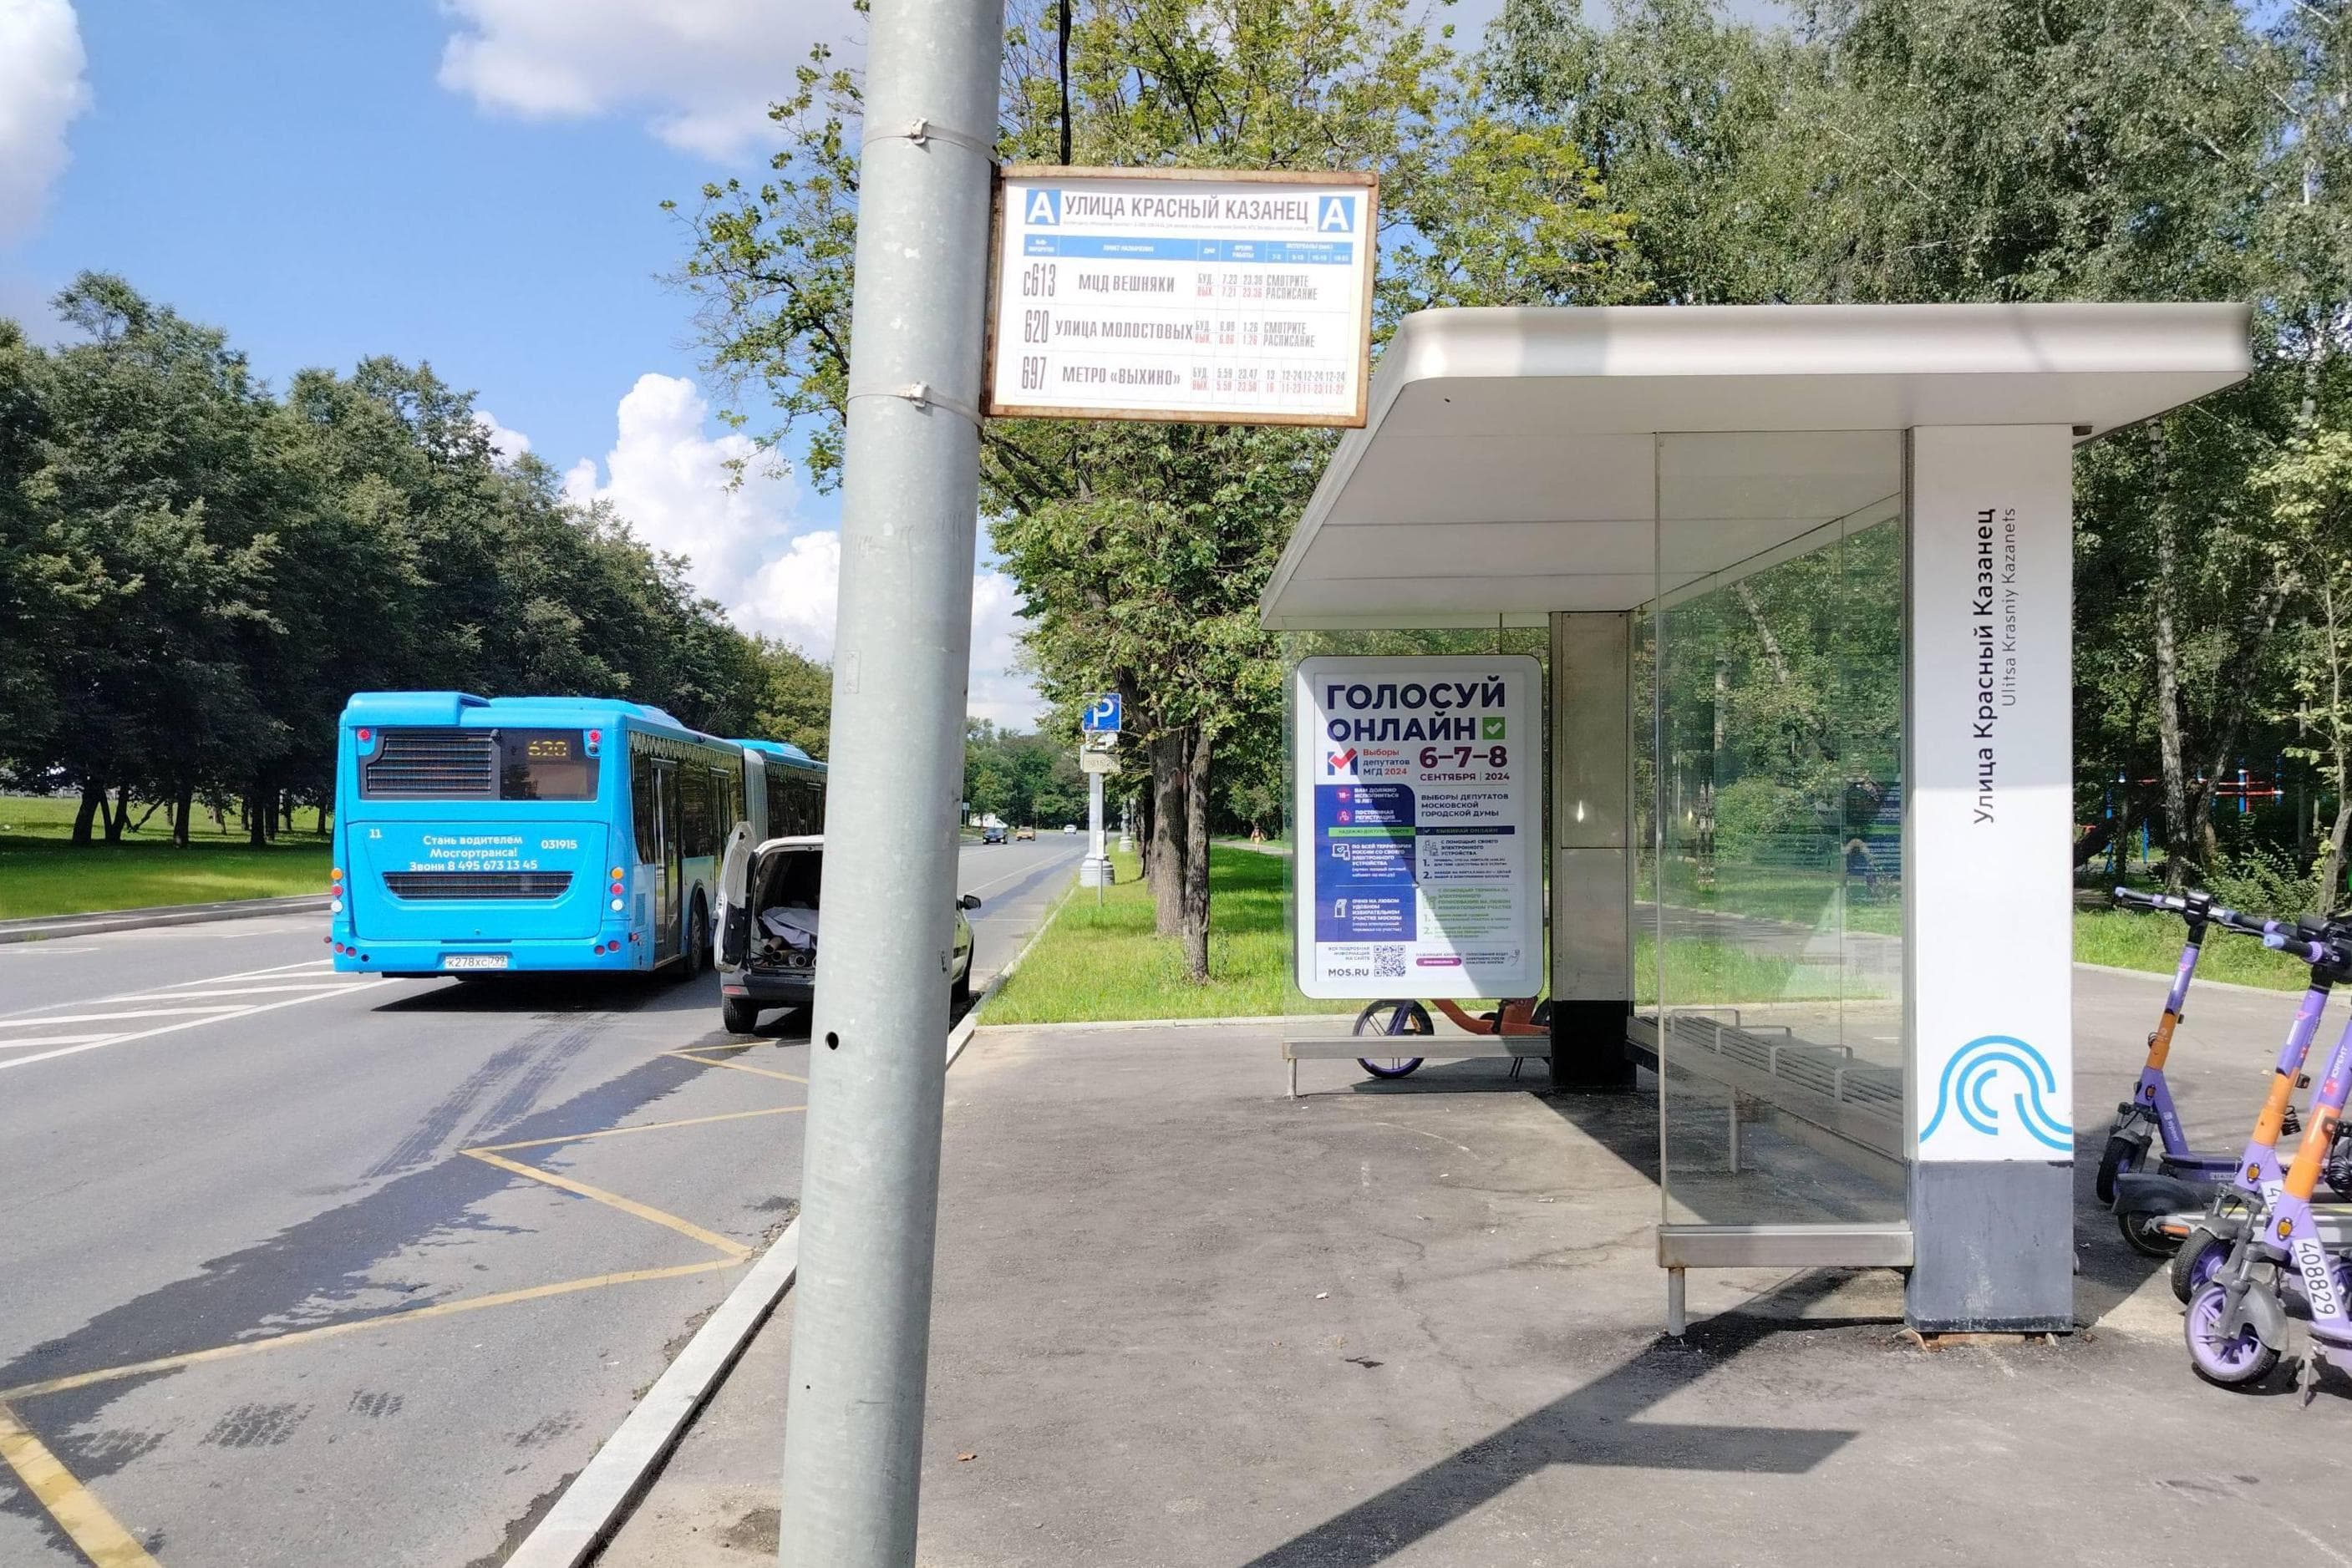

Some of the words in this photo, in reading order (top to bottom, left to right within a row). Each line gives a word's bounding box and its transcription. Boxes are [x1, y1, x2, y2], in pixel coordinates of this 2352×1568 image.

[1065, 195, 1125, 220] УЛИЦА
[1131, 195, 1219, 218] КРАСНЫЙ
[1225, 199, 1308, 224] КАЗАНЕЦ
[1079, 274, 1109, 292] МЦД
[1113, 275, 1175, 293] ВЕШНЯКИ
[1266, 274, 1309, 287] СМОТРИТЕ
[1266, 287, 1318, 301] РАСПИСАНИЕ
[1024, 309, 1049, 343] 620
[1054, 320, 1098, 338] УЛИЦА
[1101, 322, 1193, 340] МОЛОСТОВЫХ
[1264, 322, 1307, 335] СМОТРИТЕ
[1263, 334, 1315, 348] РАСПИСАНИЕ
[1022, 356, 1047, 390] 697
[1062, 366, 1106, 383] МЕТРО
[1110, 368, 1181, 385] «ВЫХИНО»
[1238, 368, 1257, 379] 23.47
[2001, 507, 2016, 583] Kazanets
[1973, 508, 1996, 615] Казанец
[2001, 588, 2019, 651] Krasniy
[1327, 675, 1505, 710] ГОЛОСУЙ
[1973, 625, 1998, 738] Красный
[2001, 657, 2016, 706] Ulitsa
[1327, 711, 1476, 742] ОНЛАЙН
[1363, 748, 1400, 757] Выборы
[1363, 759, 1410, 768] депутатов
[1420, 773, 1476, 781] СЕНТЯБРЯ
[1974, 748, 1996, 825] Улица
[369, 829, 382, 839] 11
[423, 835, 456, 845] Стань
[460, 835, 522, 845] водителем
[541, 840, 577, 850] 031915
[409, 861, 444, 871] Звони
[447, 861, 455, 870] 8
[458, 860, 480, 870] 495
[483, 860, 504, 870] 673
[506, 860, 520, 870] 13
[522, 860, 537, 870] 45
[429, 848, 517, 859] Мосгортранса!
[1328, 968, 1369, 977] MOS.RU
[2299, 1242, 2336, 1315] 408829
